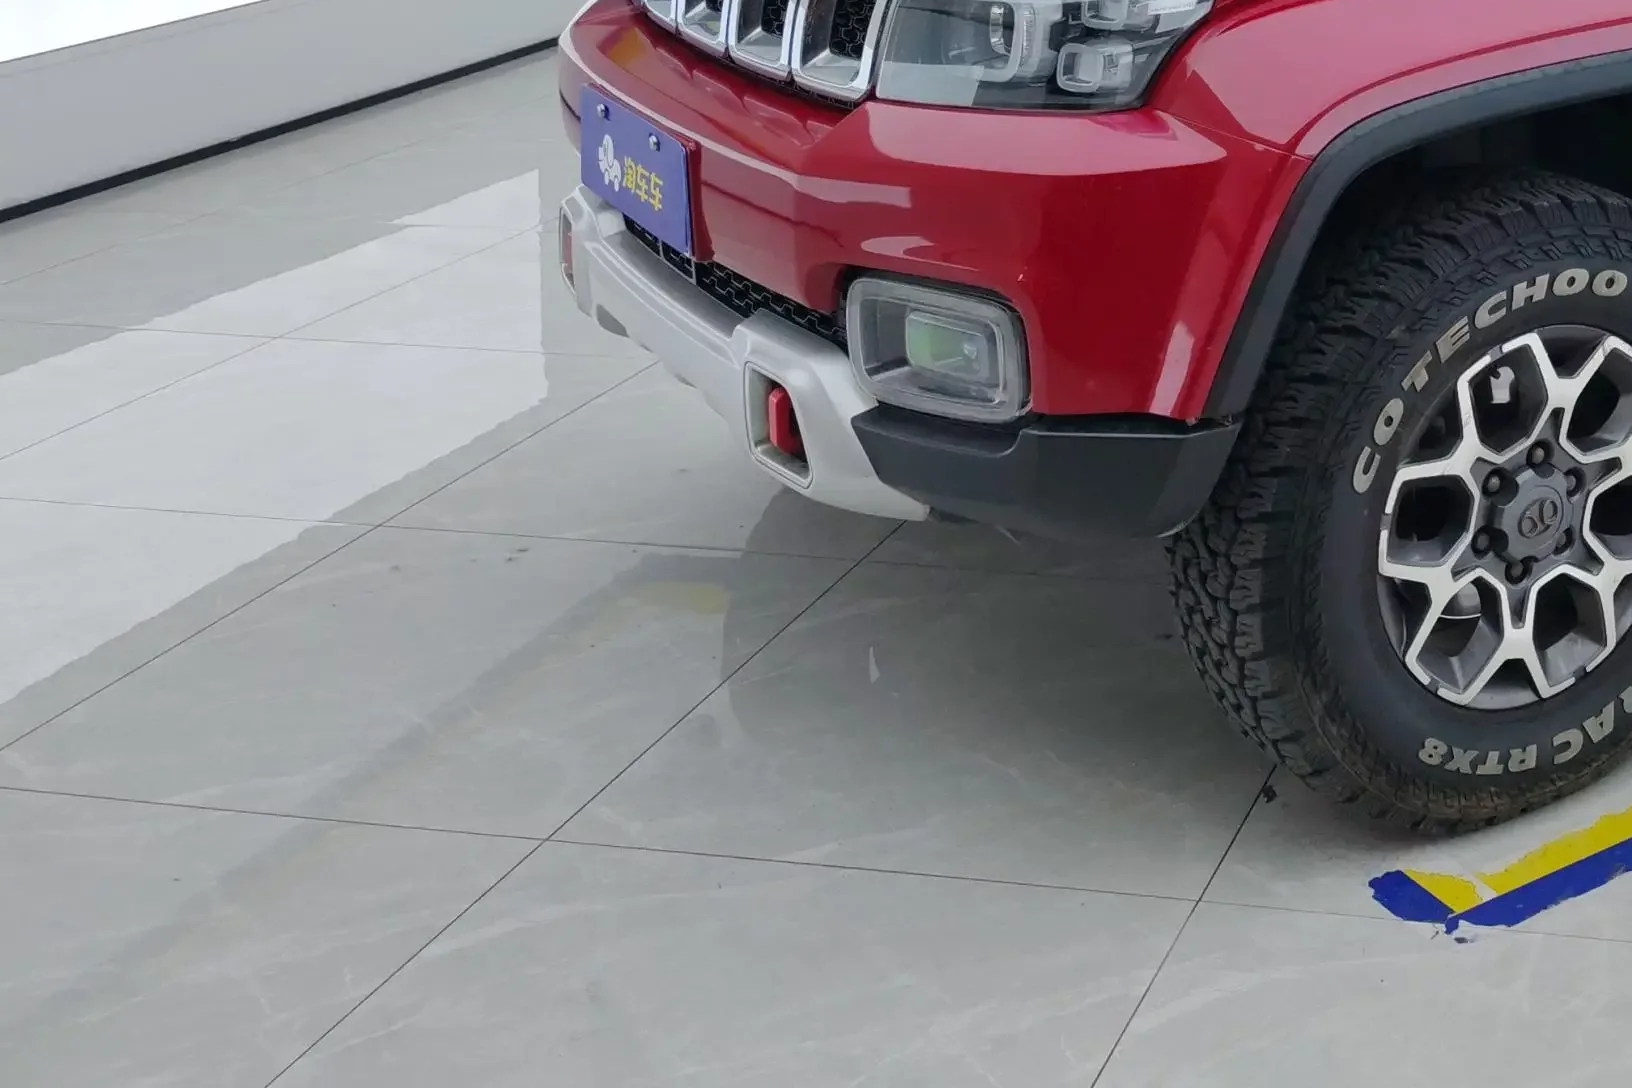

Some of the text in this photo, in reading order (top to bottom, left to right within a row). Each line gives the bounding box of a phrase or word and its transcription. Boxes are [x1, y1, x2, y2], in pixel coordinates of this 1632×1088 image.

[622, 156, 664, 212] 淘车车
[1353, 267, 1628, 494] COTECHOO
[1417, 737, 1538, 775] RTX8
